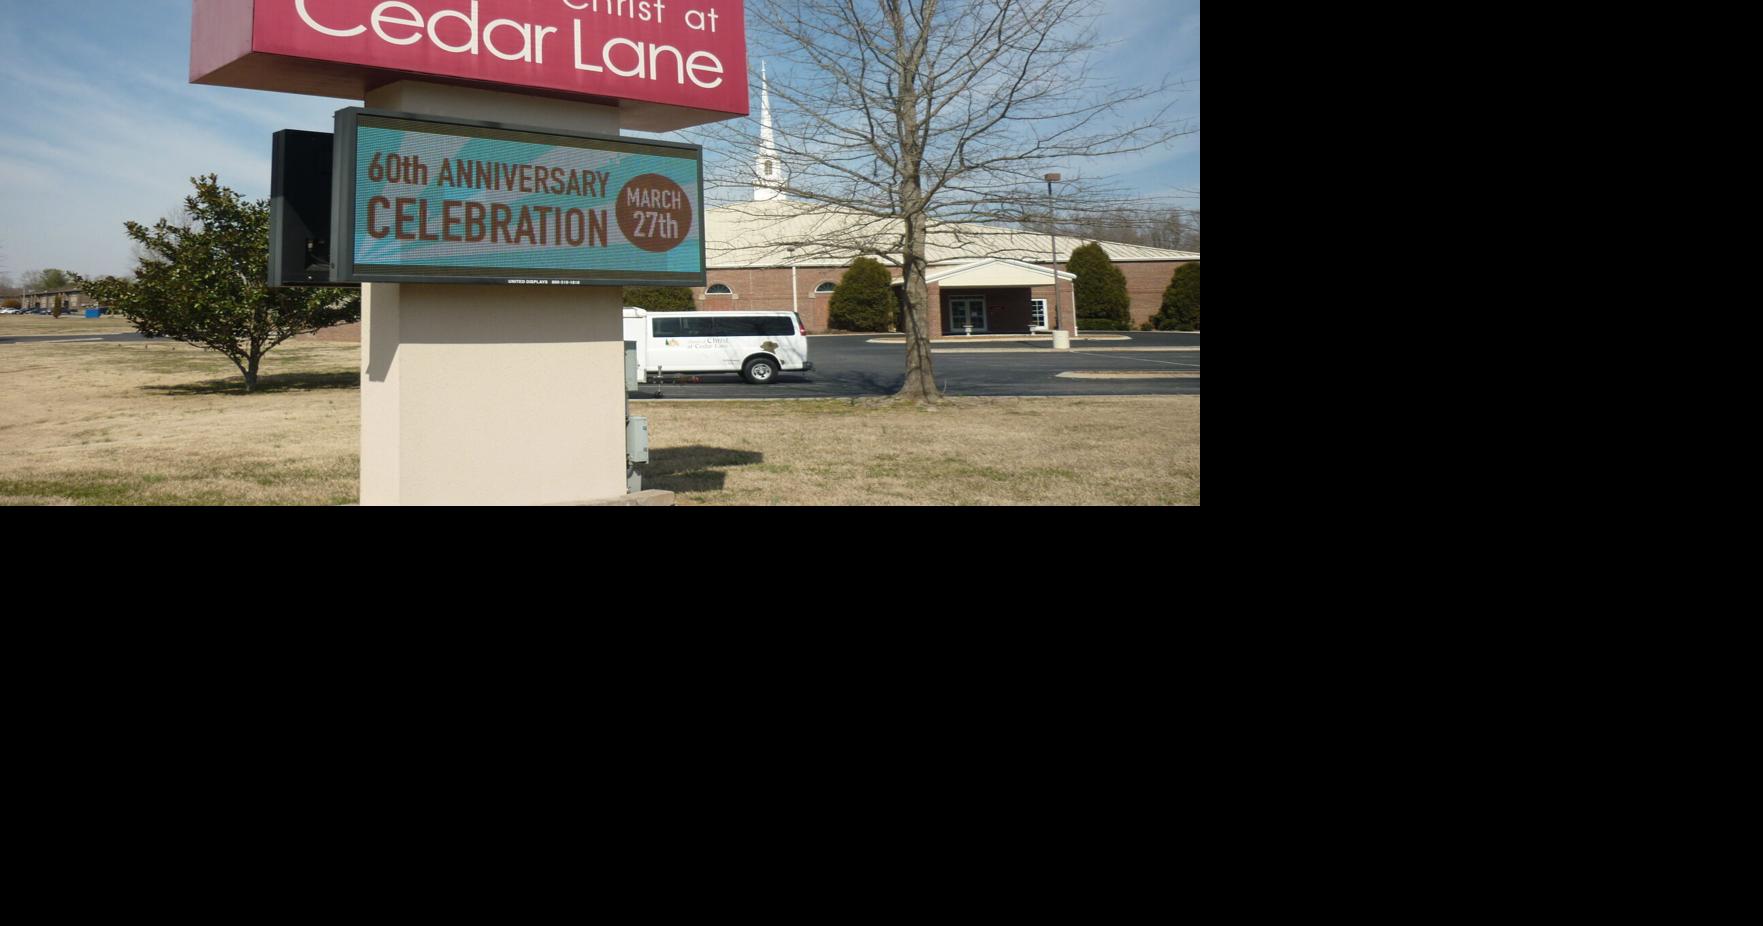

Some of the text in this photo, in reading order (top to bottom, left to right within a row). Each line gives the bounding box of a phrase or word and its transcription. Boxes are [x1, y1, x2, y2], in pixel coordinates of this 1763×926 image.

[562, 0, 719, 33] rist at
[295, 0, 724, 89] Cedar Lane
[367, 151, 610, 198] 60th ANNIVERSARY
[626, 187, 682, 210] MARCH
[366, 195, 609, 248] CELEBRATION
[632, 210, 679, 239] 27th
